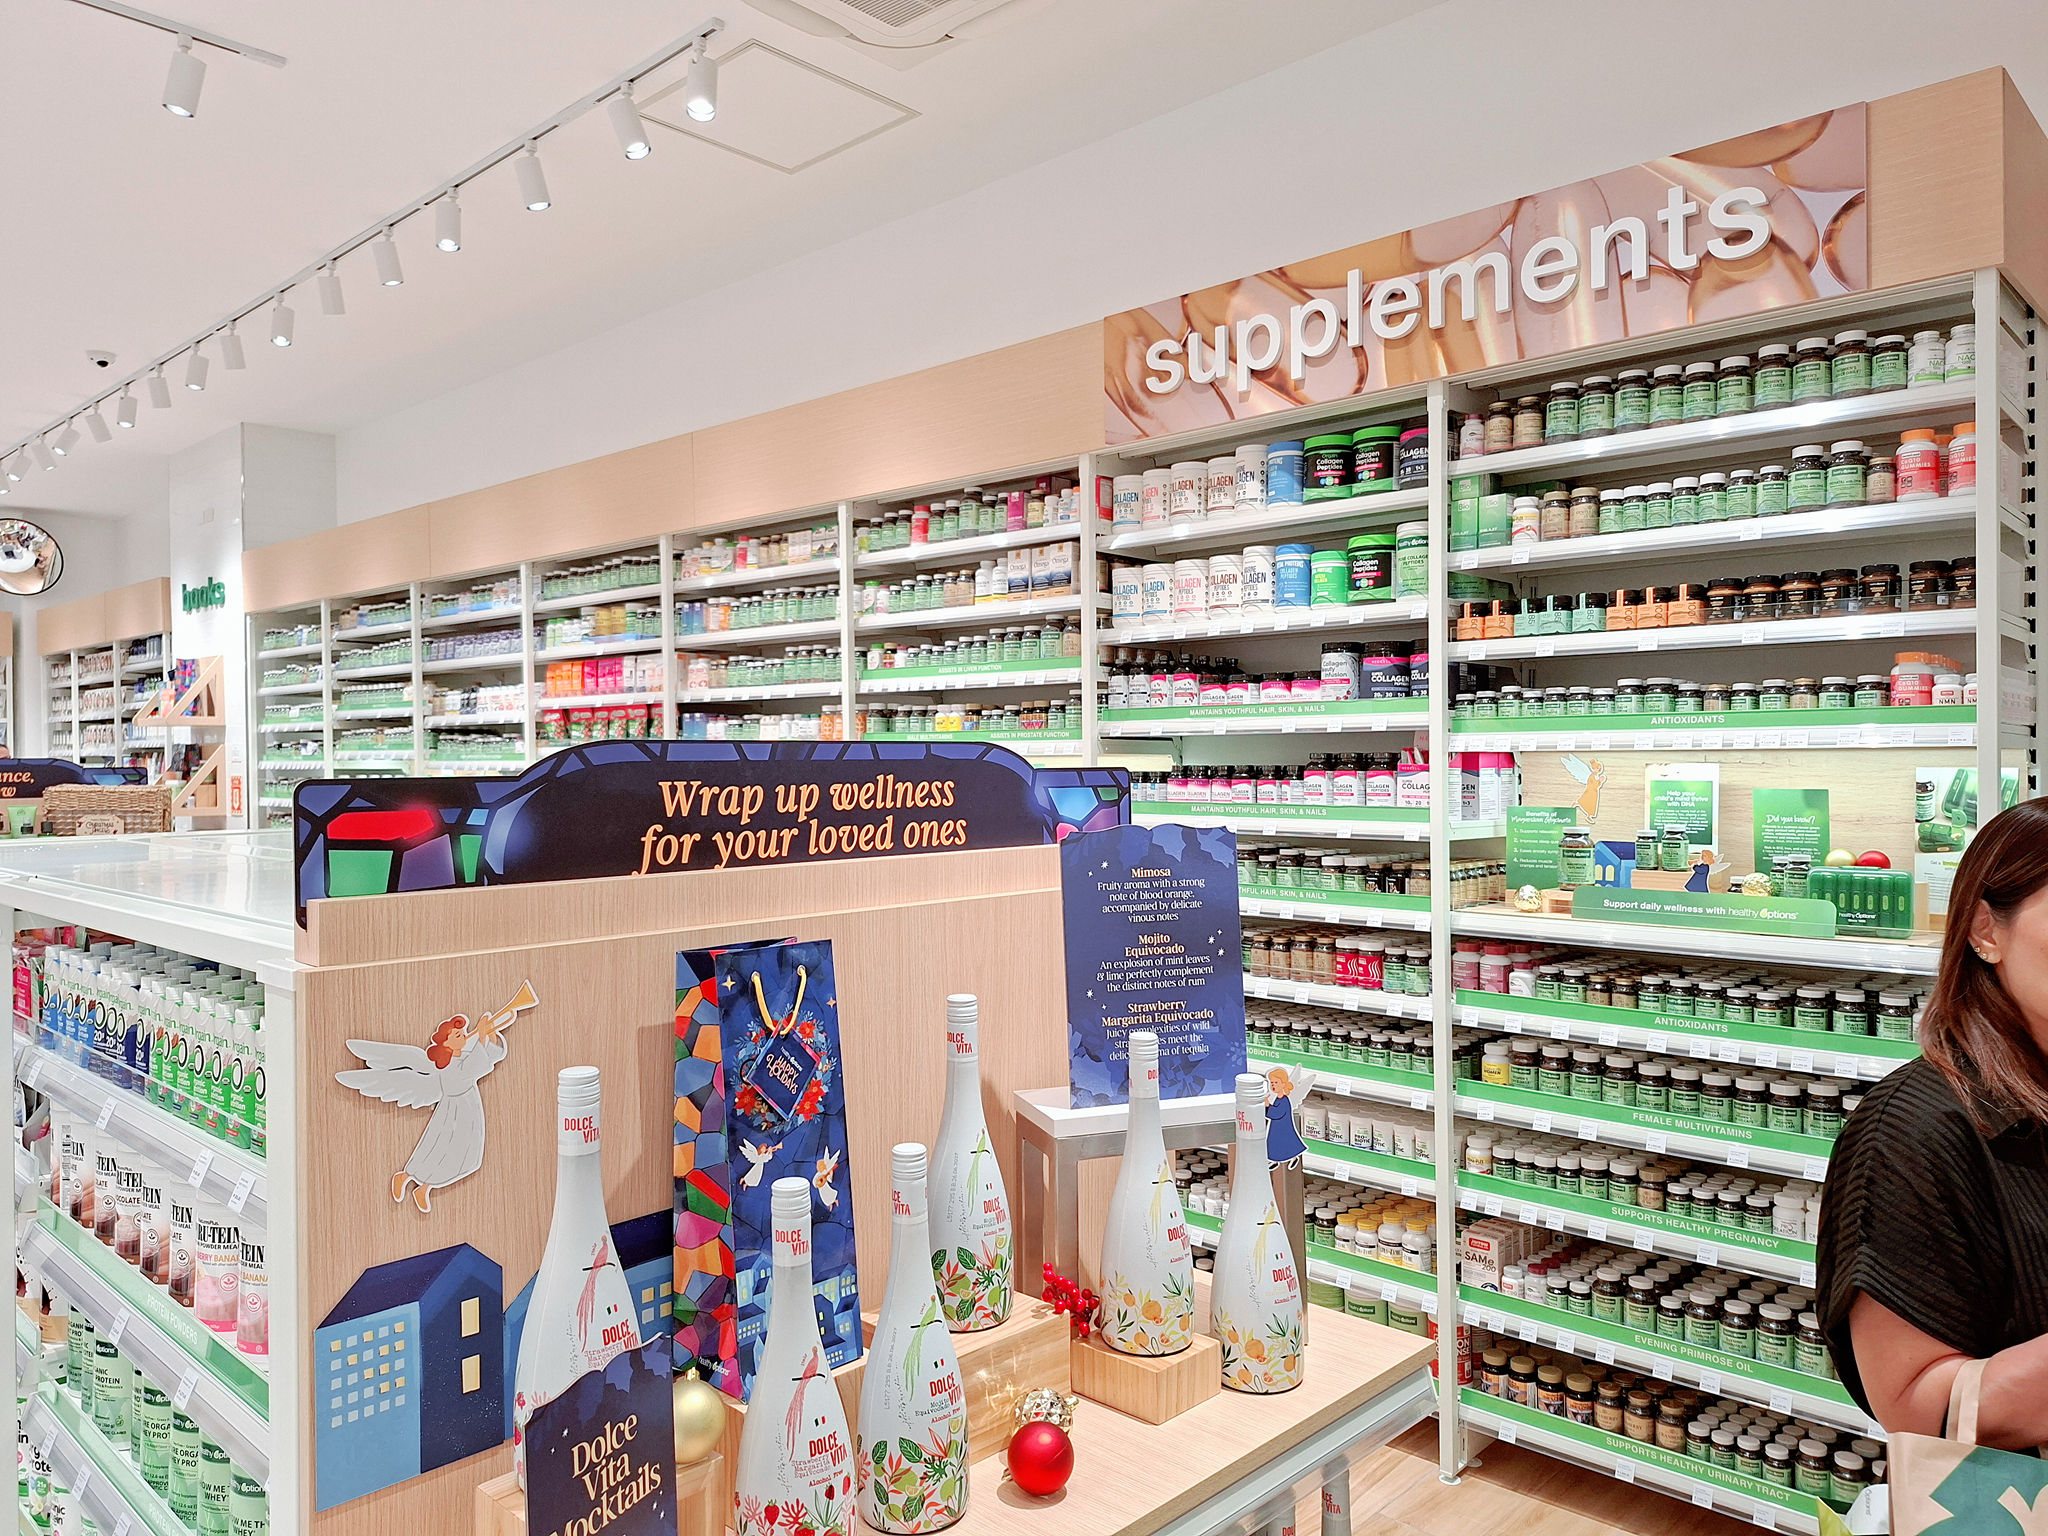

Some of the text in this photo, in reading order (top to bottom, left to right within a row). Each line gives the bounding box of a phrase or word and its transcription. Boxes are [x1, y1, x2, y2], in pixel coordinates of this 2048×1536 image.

[1145, 185, 1772, 394] supplements
[1316, 458, 1344, 466] Collagen
[1356, 451, 1380, 460] Collagen
[1356, 458, 1379, 466] Peptides
[1323, 660, 1348, 668] Collagen
[1372, 674, 1410, 682] COLLAGEN
[1190, 708, 1223, 716] MAINTAINS
[1224, 706, 1258, 715] YOUTHFUL
[1259, 706, 1277, 714] HAIR,
[1304, 704, 1326, 712] NAILS
[1651, 714, 1725, 725] ANTIOXIDANTS
[658, 774, 956, 825] Wrap up wellness
[1225, 806, 1258, 814] YOUTHFUL
[1260, 807, 1278, 815] HAIR,
[1280, 808, 1298, 816] SKIN,
[1306, 808, 1326, 816] NAILS
[1766, 814, 1780, 824] Did
[632, 815, 968, 877] for your loved ones
[1131, 867, 1172, 878] Mimosa
[1097, 878, 1206, 892] Fruity aroma with a strong
[1109, 892, 1128, 902] note
[1128, 891, 1138, 900] of
[1140, 890, 1164, 900] blood
[1239, 888, 1259, 896] THFUL
[1260, 888, 1278, 897] HAIR,
[1280, 890, 1298, 898] SKIN,
[1306, 892, 1327, 900] NAILS
[1102, 900, 1203, 914] accompanied by delicate
[1603, 899, 1638, 910] Support
[1640, 902, 1662, 913] daily
[1663, 904, 1704, 914] wellness
[1704, 905, 1726, 916] with
[1728, 908, 1758, 919] healthy
[1128, 912, 1179, 923] vinous notes
[1138, 933, 1171, 946] Mojito
[1124, 944, 1185, 958] Equivocado
[1100, 954, 1210, 970] An explosion of mint leaves
[1096, 965, 1214, 982] & lime perfectly complement
[1107, 978, 1206, 992] the distinct notes of rum
[1127, 1000, 1187, 1014] Strawberry
[1102, 1008, 1214, 1028] Margarita Equivocado
[1654, 1016, 1728, 1032] ANTIOXIDANTS
[1106, 1028, 1128, 1040] Juicy
[1182, 1022, 1191, 1032] of
[1192, 1020, 1210, 1031] wild
[1168, 1036, 1188, 1044] meet
[1190, 1034, 1204, 1042] the
[956, 1043, 972, 1054] VITA
[1109, 1050, 1130, 1062] delic
[1171, 1046, 1180, 1056] of
[1182, 1044, 1210, 1056] tequila
[1249, 1048, 1280, 1058] OBIOTICS
[777, 1056, 799, 1080] HAPPY
[564, 1116, 594, 1132] DOLCE
[1238, 1120, 1254, 1132] VITA
[1632, 1112, 1753, 1140] FEMALE MULTIVITAMINS
[894, 1203, 911, 1216] VITA
[984, 1196, 1001, 1214] DOLCE
[198, 1223, 240, 1244] RU-TEIN
[776, 1228, 802, 1243] DOLCE
[1167, 1224, 1186, 1242] DOLCE
[1611, 1206, 1780, 1250] SUPPORTS HEALTHY PREGNANCY
[791, 1240, 810, 1256] VITA
[1464, 1251, 1494, 1266] SAMe
[1272, 1264, 1293, 1283] DOLCE
[1482, 1264, 1496, 1272] 200
[147, 1294, 198, 1345] PROTEIN POWDERS
[602, 1318, 631, 1346] DOLCE
[623, 1330, 638, 1350] VITA
[1634, 1334, 1754, 1374] EVENING PRIMROSE OIL
[96, 1376, 120, 1384] PROTEIN
[929, 1372, 955, 1398] DOLCE
[930, 1398, 949, 1409] Mojito
[948, 1386, 962, 1406] VITA
[914, 1404, 950, 1418] Equivocado
[930, 1406, 961, 1424] Alcohol Free
[571, 1413, 639, 1479] Dolce
[808, 1430, 838, 1458] DOLCE
[791, 1454, 830, 1468] Strawberry
[830, 1447, 848, 1467] VITA
[582, 1452, 631, 1501] Vita
[1605, 1436, 1790, 1502] SUPPORTS HEALTHY URINARY TRACT
[808, 1470, 844, 1488] Alcohol Free
[204, 1492, 226, 1502] WHEY
[549, 1463, 662, 1536] Mocktails
[1326, 1502, 1342, 1515] VITA
